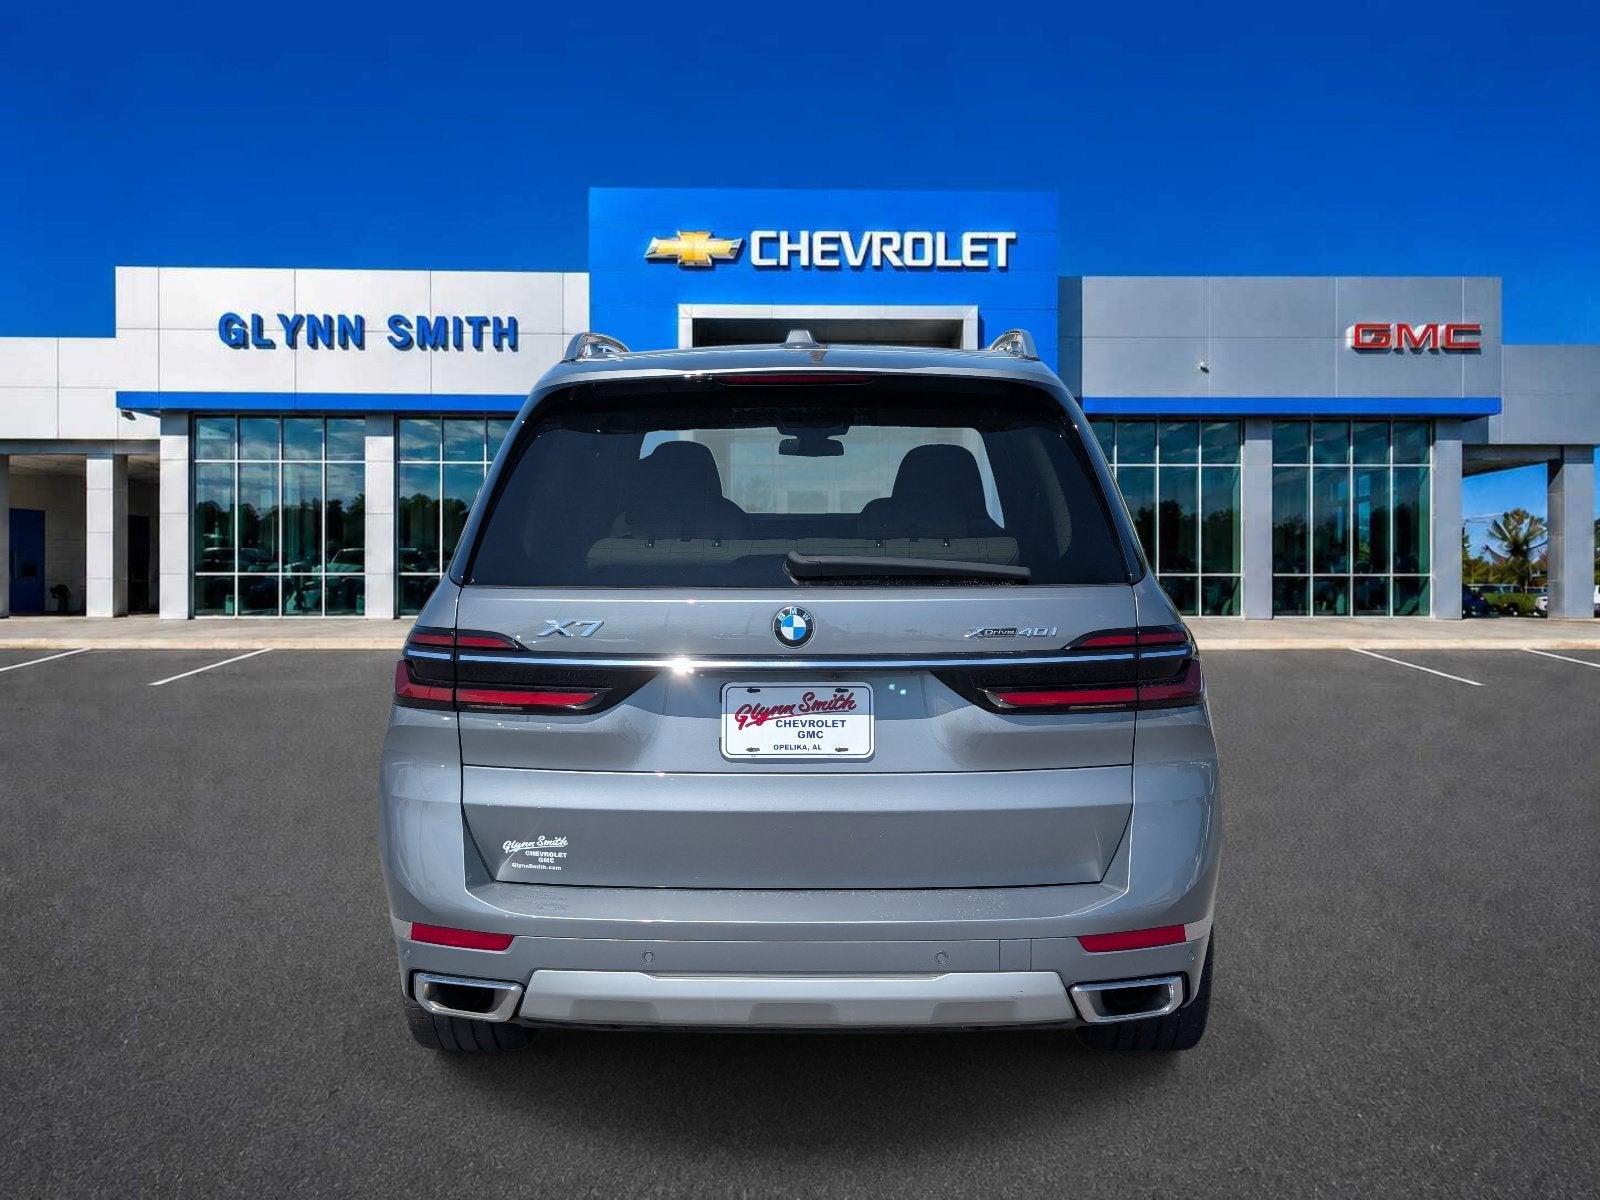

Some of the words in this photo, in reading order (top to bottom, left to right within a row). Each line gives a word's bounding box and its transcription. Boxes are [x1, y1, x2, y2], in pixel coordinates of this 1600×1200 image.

[750, 230, 1017, 268] CHEVROLET
[218, 312, 367, 350] GLYNN
[387, 314, 519, 352] SMITH
[1350, 322, 1483, 353] GMC
[777, 606, 811, 621] BMW
[537, 619, 605, 638] X7
[734, 702, 797, 731] Glynn
[797, 691, 858, 713] Smith
[775, 719, 847, 728] CHEVROLET
[797, 730, 824, 739] GMC
[773, 744, 810, 752] OPELIKA,
[502, 839, 536, 854] Glynn
[536, 835, 569, 848] Smith
[524, 850, 568, 858] CHEVROLET
